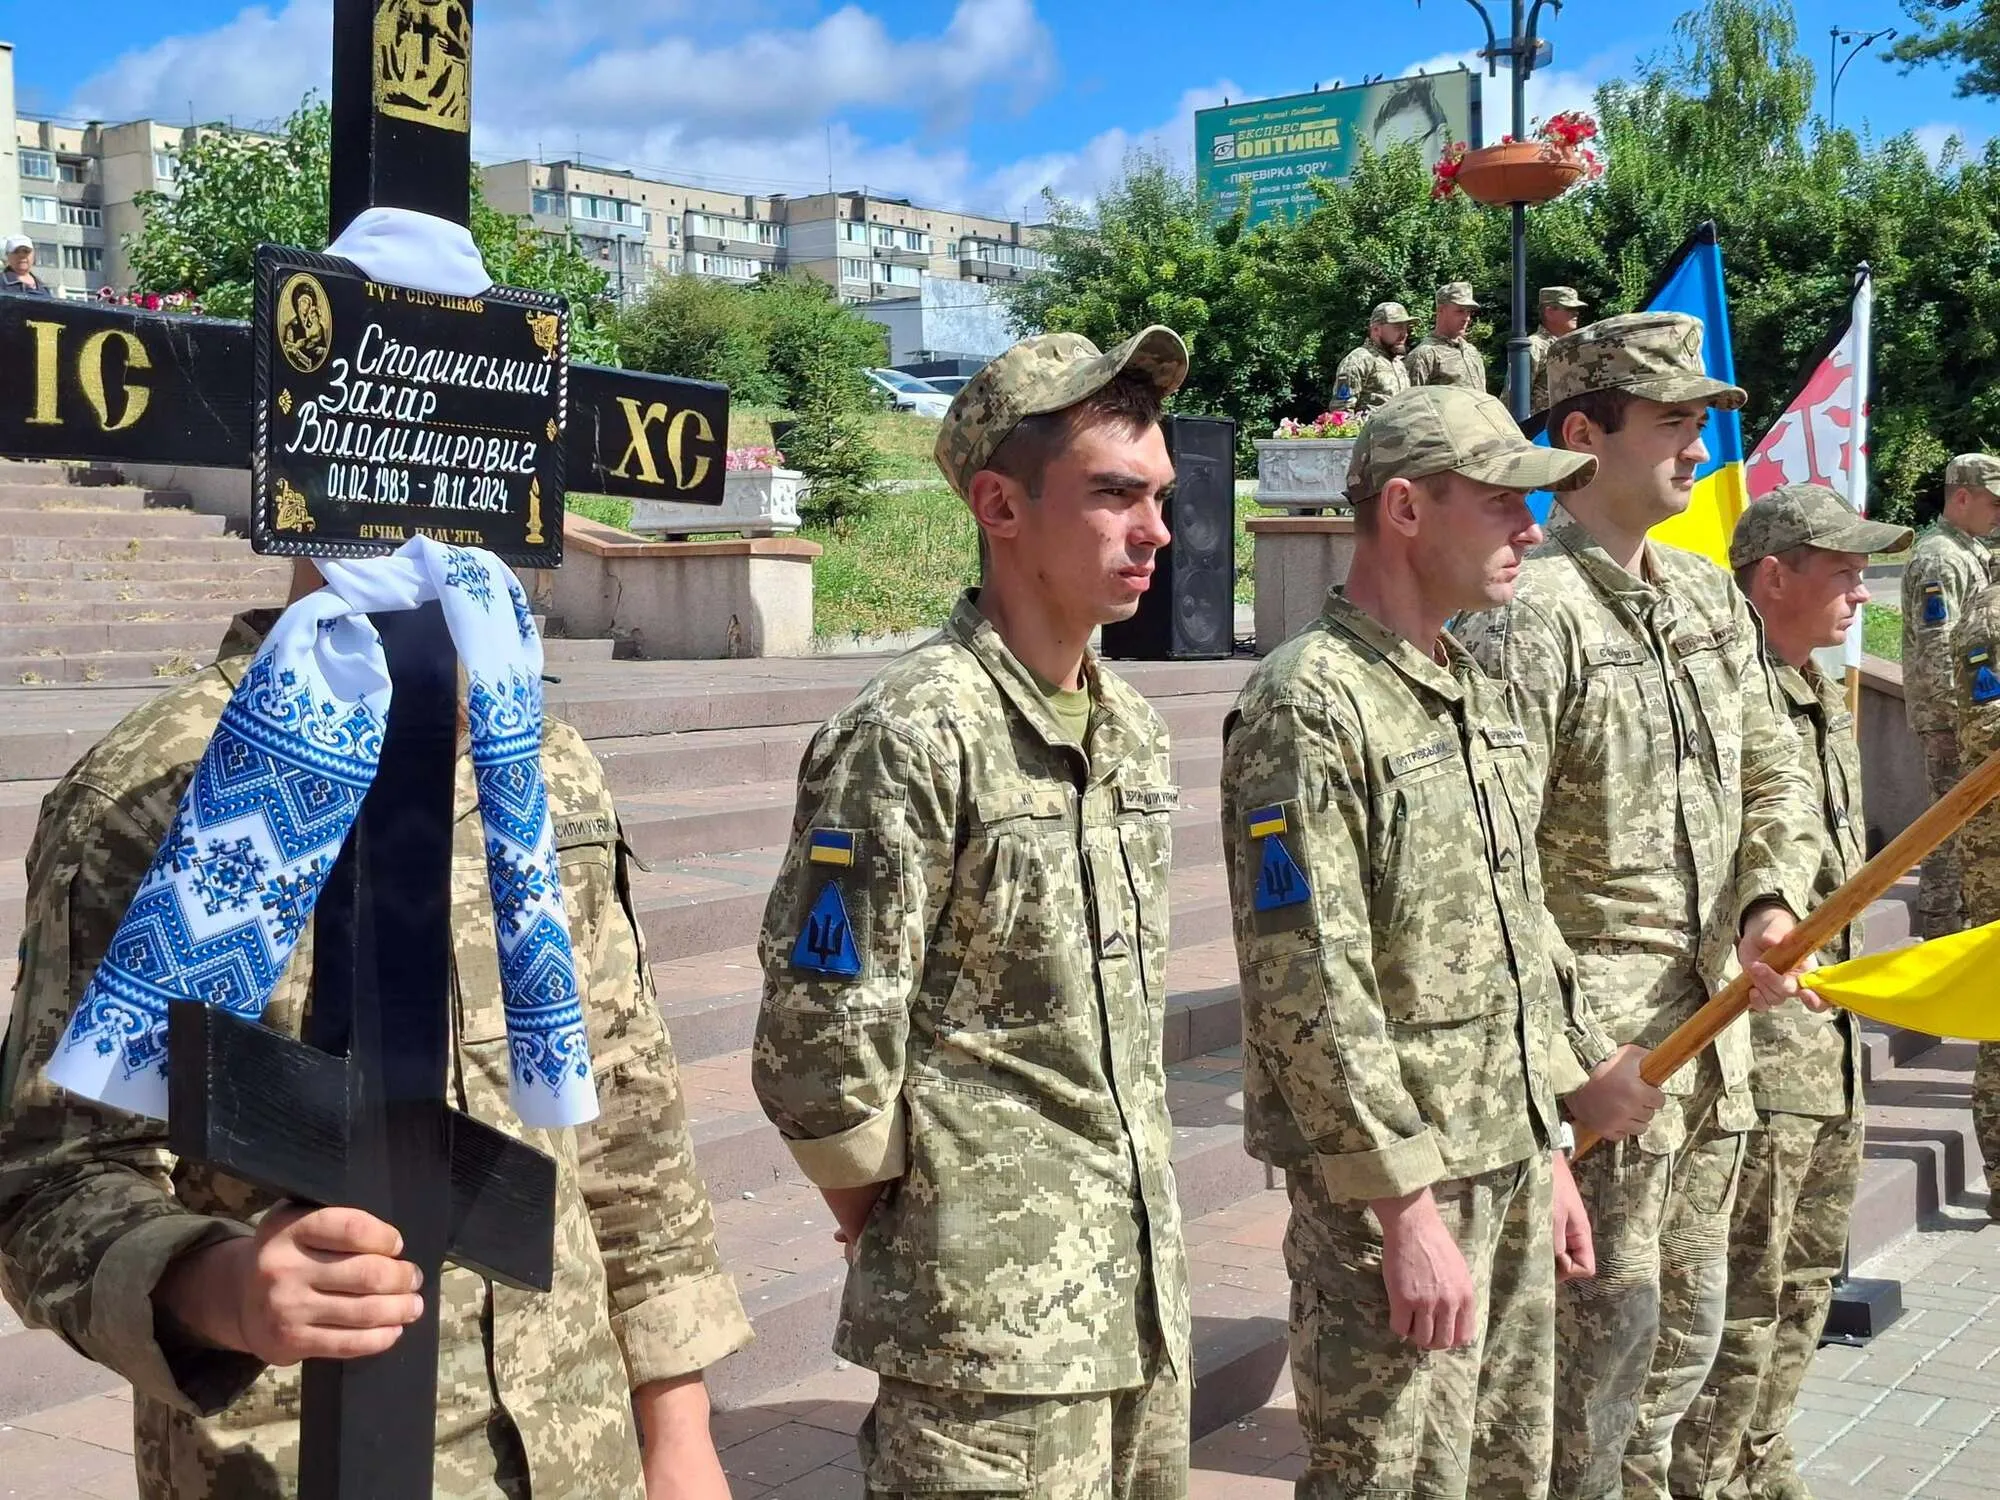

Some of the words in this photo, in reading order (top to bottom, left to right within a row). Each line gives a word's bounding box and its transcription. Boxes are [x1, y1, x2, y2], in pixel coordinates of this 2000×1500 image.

[1237, 122, 1301, 140] ЕКСПРЕС
[1236, 128, 1340, 159] ОПТИКА
[1230, 166, 1293, 184] ПЕРЕВІРКА
[1296, 161, 1327, 176] ЗОРУ
[364, 281, 400, 303] ТУТ
[318, 357, 437, 422] Захар
[327, 462, 410, 504] 01.02.1983
[431, 471, 509, 513] 18.11.2024
[359, 524, 405, 540] ВІЧНА
[553, 820, 586, 839] СИЛИ
